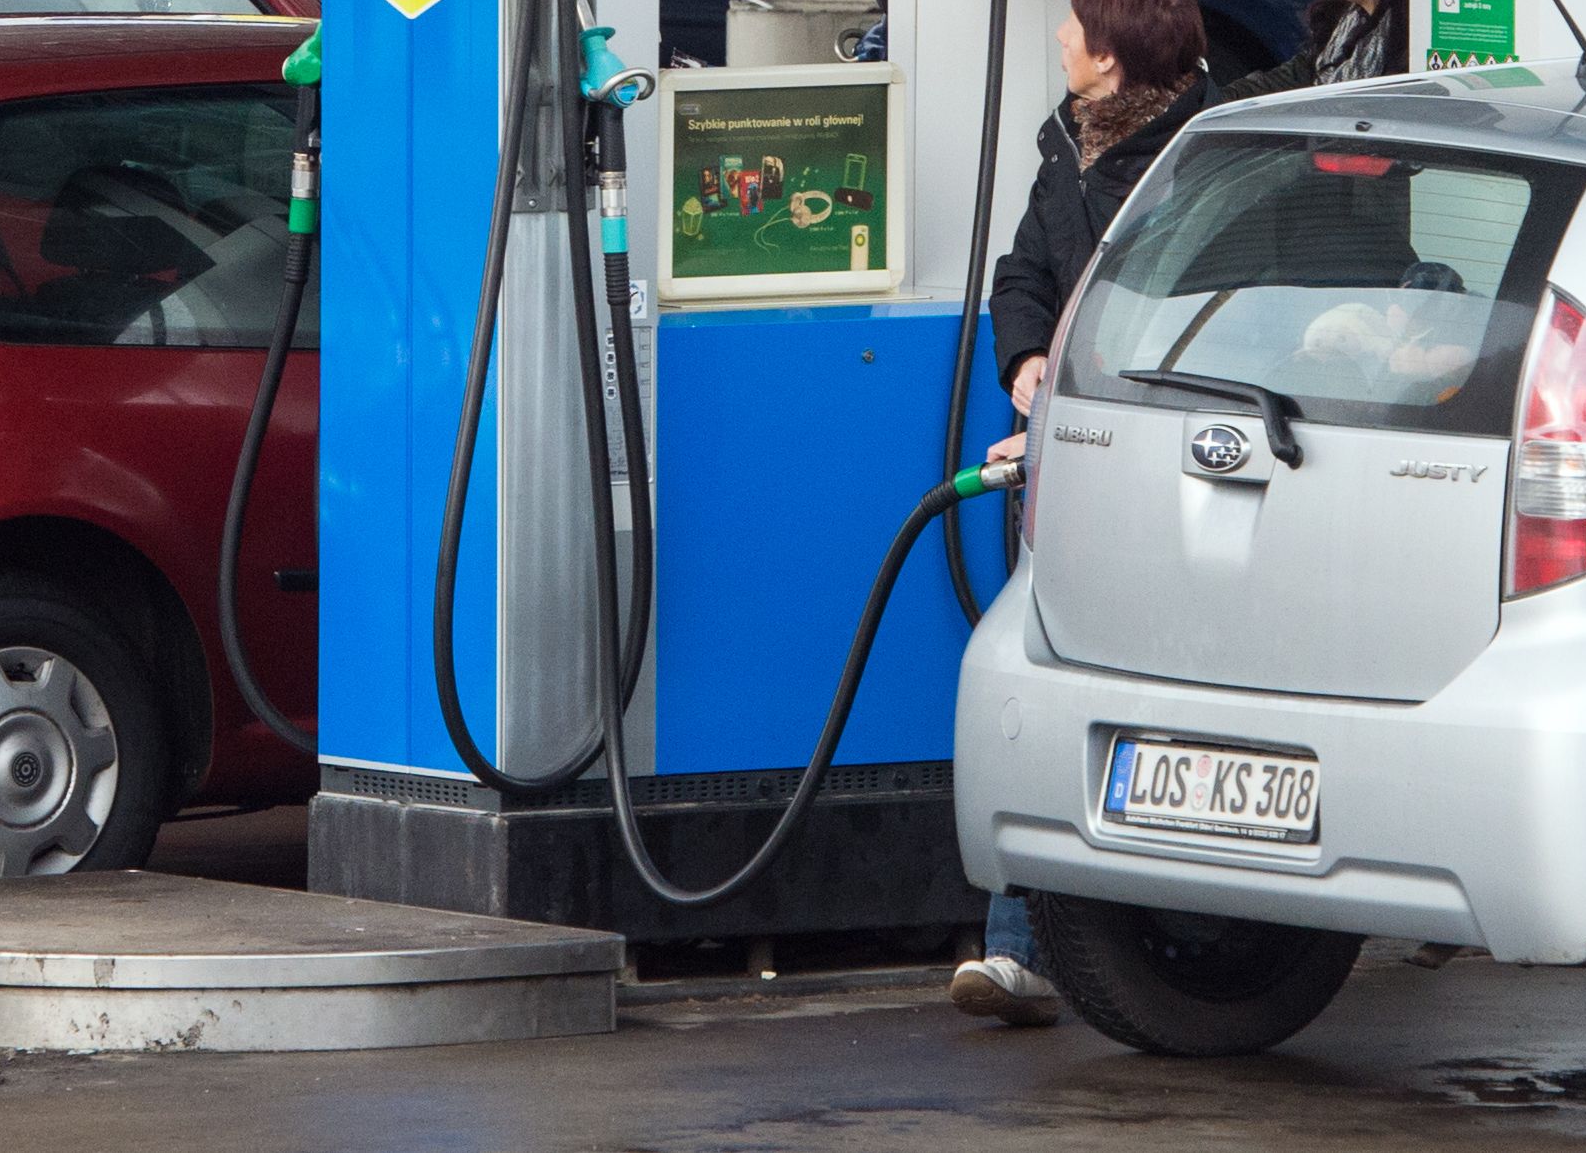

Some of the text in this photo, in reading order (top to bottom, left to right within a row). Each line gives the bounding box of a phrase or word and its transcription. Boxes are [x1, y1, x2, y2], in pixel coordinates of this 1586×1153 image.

[688, 119, 726, 132] Szybkie
[728, 116, 791, 130] punktowanie
[805, 114, 821, 126] roli
[823, 114, 864, 128] głównej!
[1053, 424, 1113, 447] SUBARU
[1389, 459, 1489, 483] JUSTY
[1115, 783, 1124, 798] D
[1130, 751, 1314, 821] LOS KS 308
